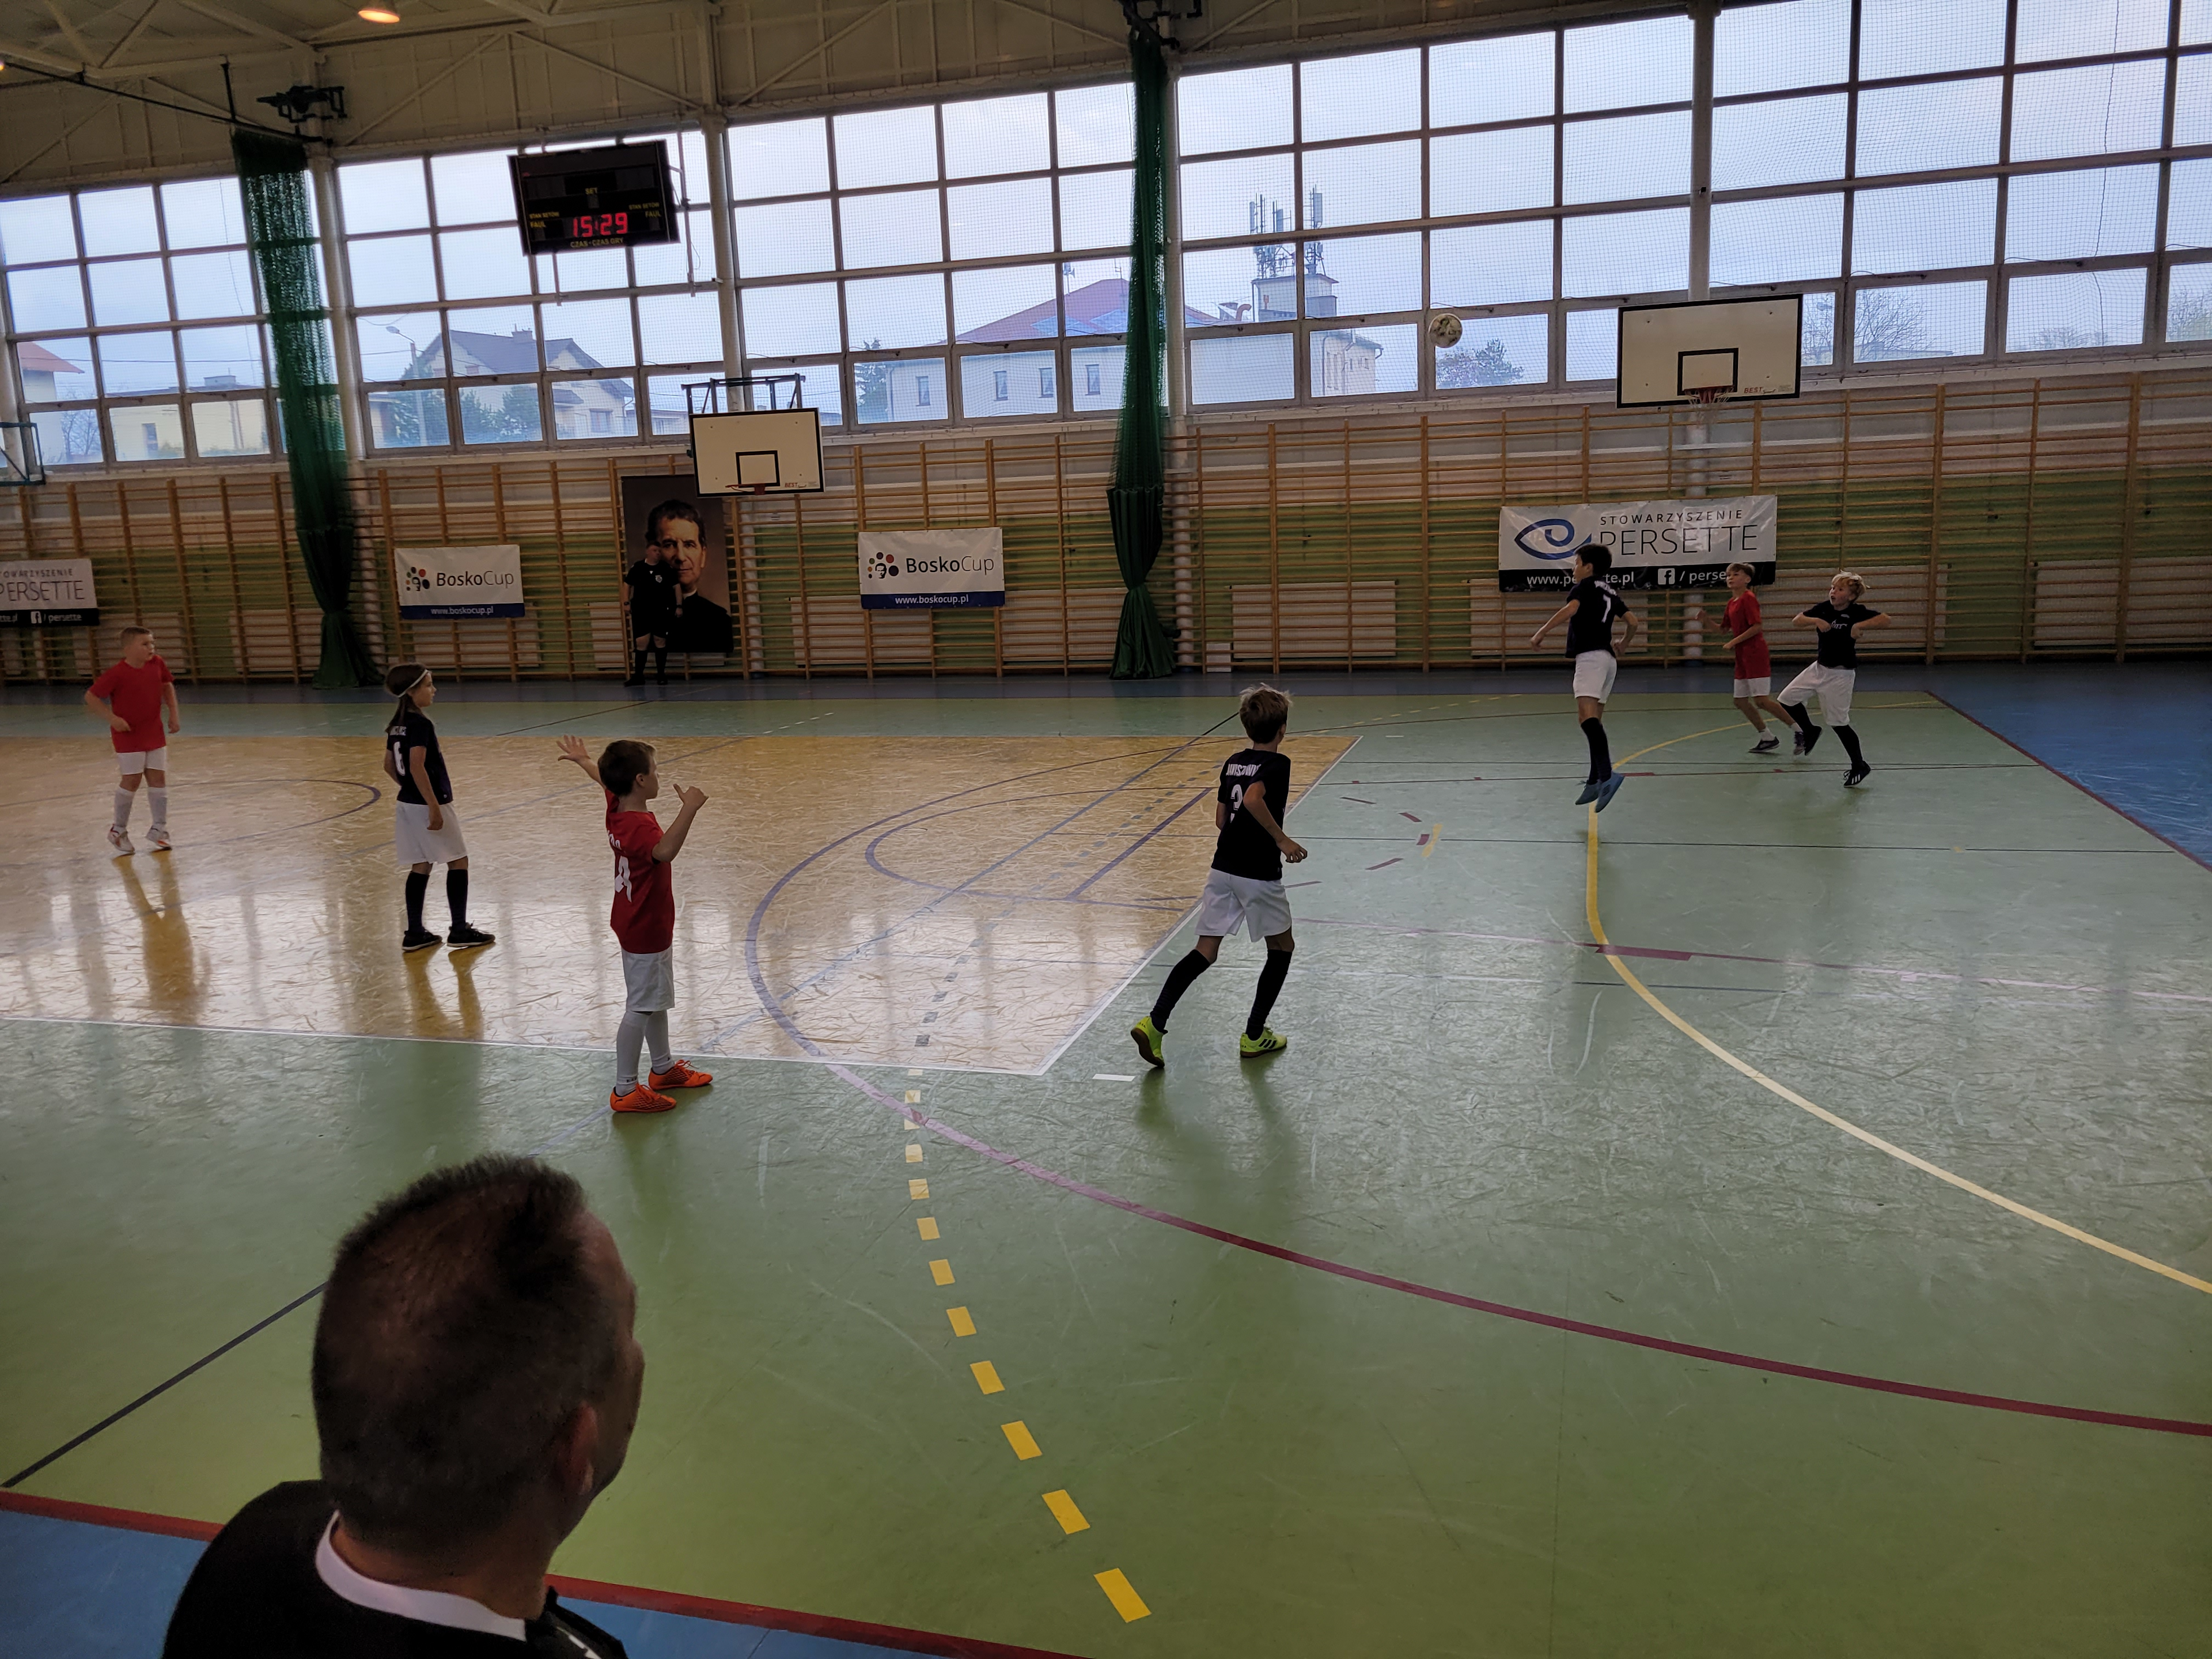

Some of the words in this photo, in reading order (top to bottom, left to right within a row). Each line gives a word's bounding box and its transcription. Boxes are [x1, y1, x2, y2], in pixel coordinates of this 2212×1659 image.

[645, 210, 662, 218] FAUL
[1600, 510, 1742, 525] STOWARZYSZENIE
[1600, 525, 1758, 555] PERSETTE
[906, 556, 994, 575] BoskoCup
[437, 570, 514, 589] BoskoCup
[895, 594, 969, 604] www.boskocup.pl
[431, 606, 494, 616] www.boskocup.pl
